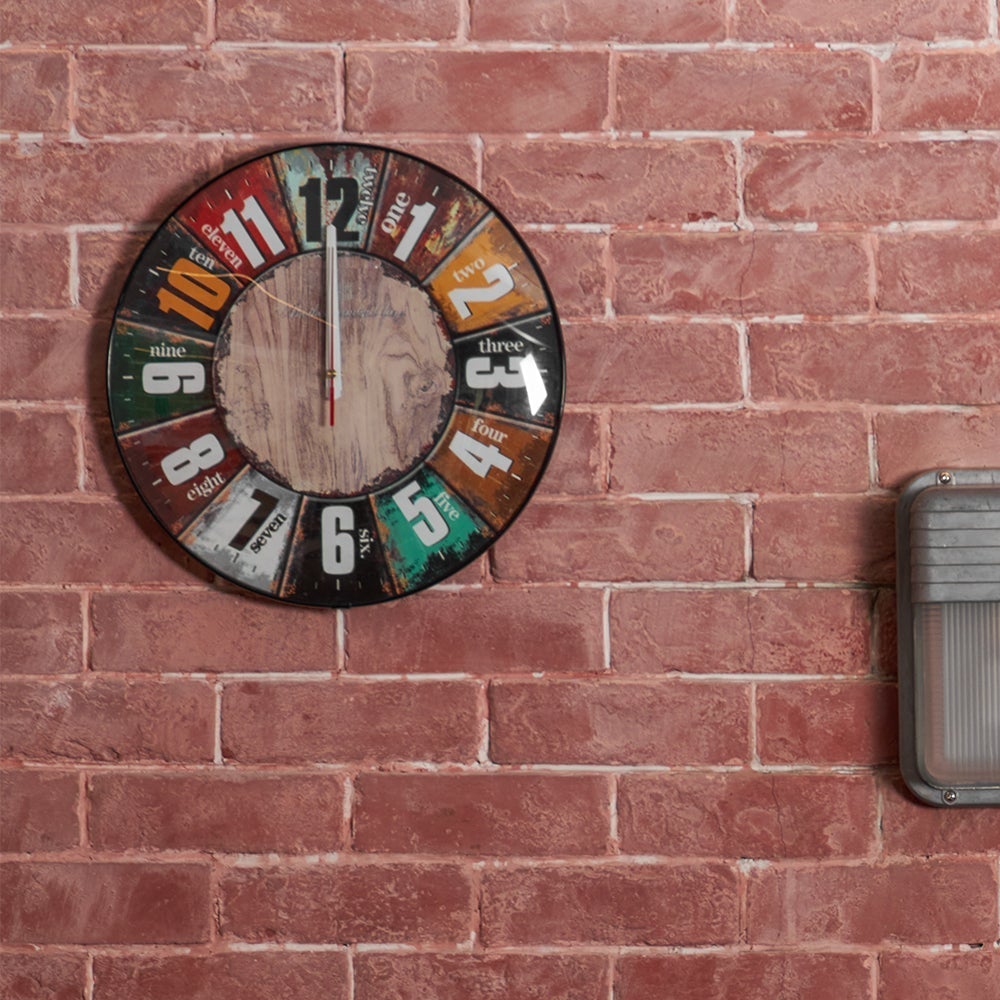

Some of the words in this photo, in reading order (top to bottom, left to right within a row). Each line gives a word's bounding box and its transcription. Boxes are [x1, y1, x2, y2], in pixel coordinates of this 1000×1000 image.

[299, 177, 360, 243] 12
[355, 166, 378, 226] twelve
[381, 191, 411, 235] one
[201, 223, 244, 270] eleven
[220, 195, 287, 269] 11
[393, 201, 437, 262] 1
[188, 247, 216, 271] ten
[452, 257, 486, 283] two
[156, 257, 231, 332] 10
[447, 263, 516, 320] 2
[150, 342, 187, 358] nine
[478, 337, 525, 354] three
[142, 361, 206, 395] 9
[465, 356, 530, 389] 3
[471, 417, 508, 443] four
[160, 432, 226, 486] 8
[448, 430, 513, 479] 4
[186, 471, 226, 501] eight
[433, 491, 460, 522] five
[228, 488, 280, 551] 7
[250, 512, 288, 554] seven
[391, 480, 449, 547] 5
[321, 505, 355, 576] 6
